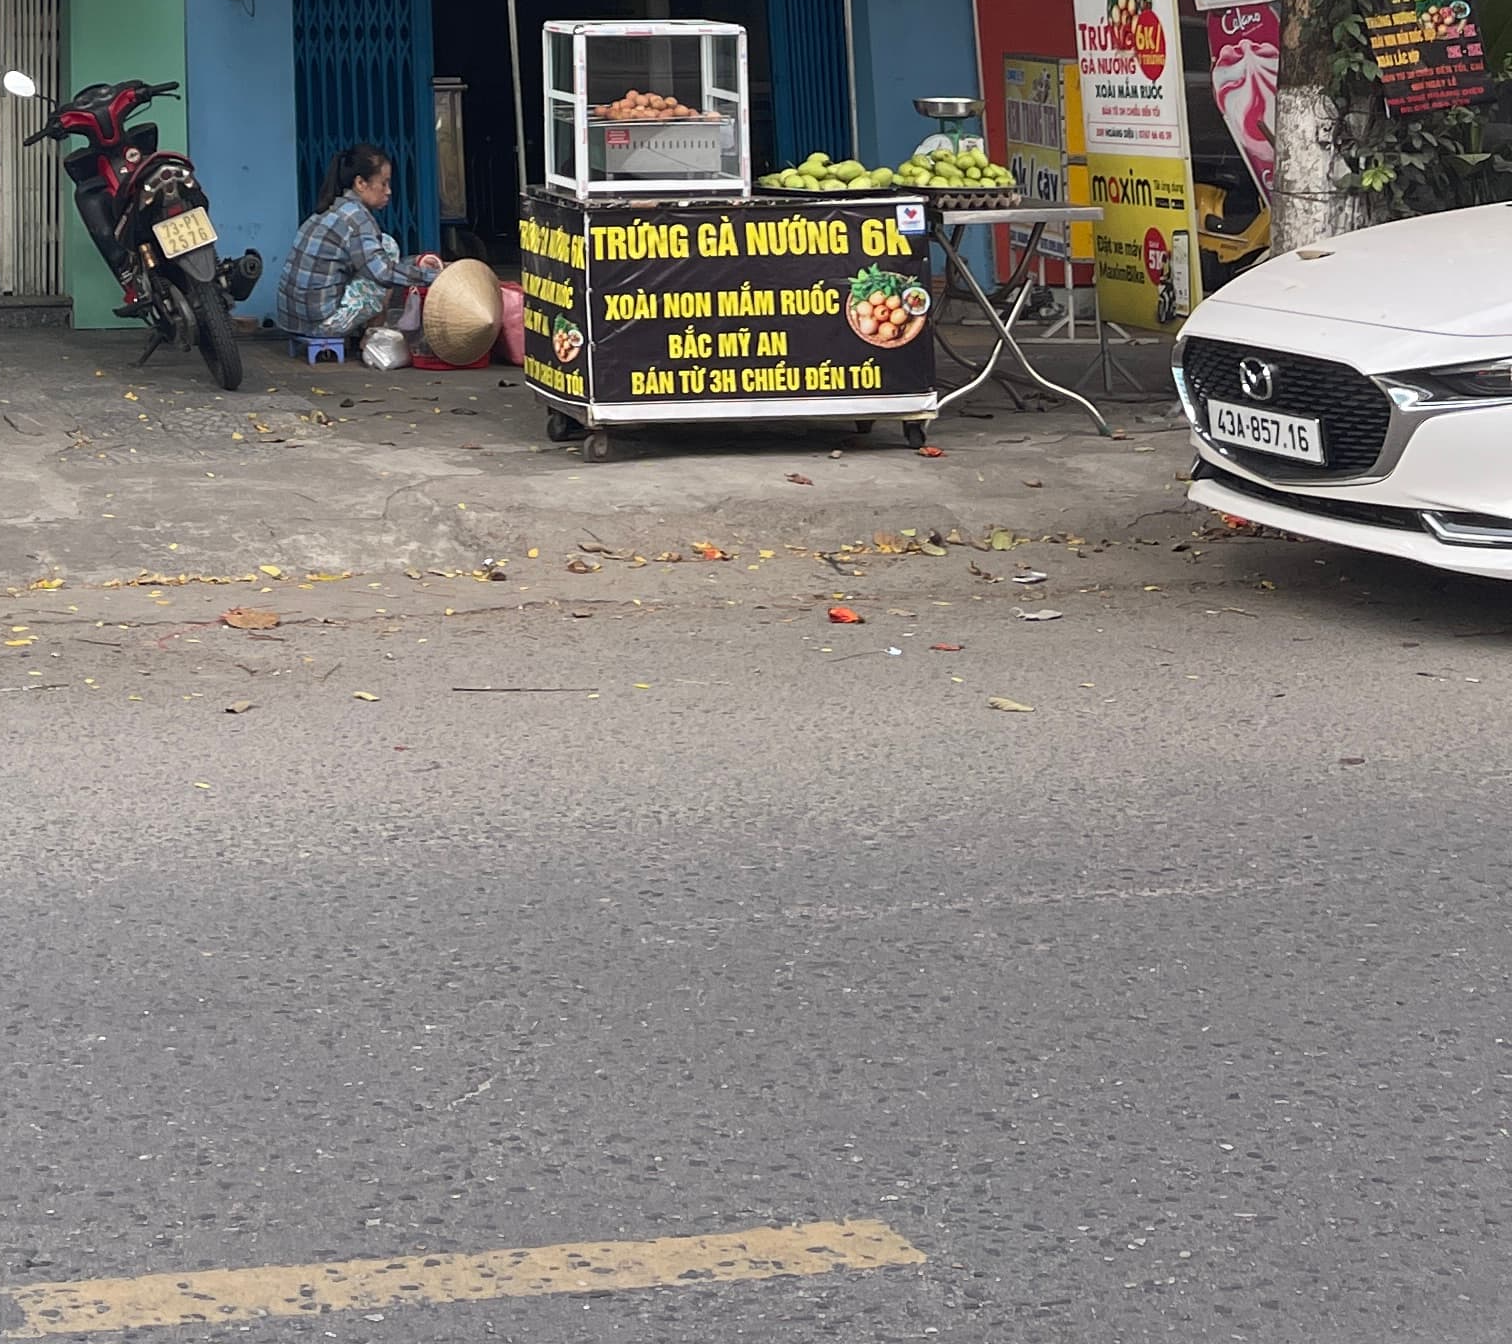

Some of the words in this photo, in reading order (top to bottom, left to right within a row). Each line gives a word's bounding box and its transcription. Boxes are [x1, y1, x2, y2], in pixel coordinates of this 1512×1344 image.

[1077, 17, 1135, 51] TRỨNG
[1080, 54, 1097, 75] GÀ
[1097, 55, 1137, 75] NƯỚNG
[1092, 168, 1153, 207] maxim
[161, 213, 200, 238] 73-P1
[169, 228, 208, 253] 2576
[590, 218, 690, 260] TRỨNG
[697, 216, 739, 258] GÀ
[745, 214, 849, 256] NƯỚNG
[861, 218, 913, 256] 6K
[604, 288, 657, 321] XOÀI
[664, 292, 712, 319] NON
[718, 281, 775, 318] MẮM
[780, 279, 840, 316] RUỐC
[668, 325, 713, 359] BẮC
[718, 327, 751, 357] MỸ
[757, 331, 787, 356] AN
[631, 363, 675, 395] BÁN
[679, 365, 707, 393] TỪ
[709, 367, 737, 392] 3H
[805, 359, 846, 390] ĐẾN
[849, 358, 882, 390] TỐI
[1218, 408, 1309, 452] 43A-857.16
